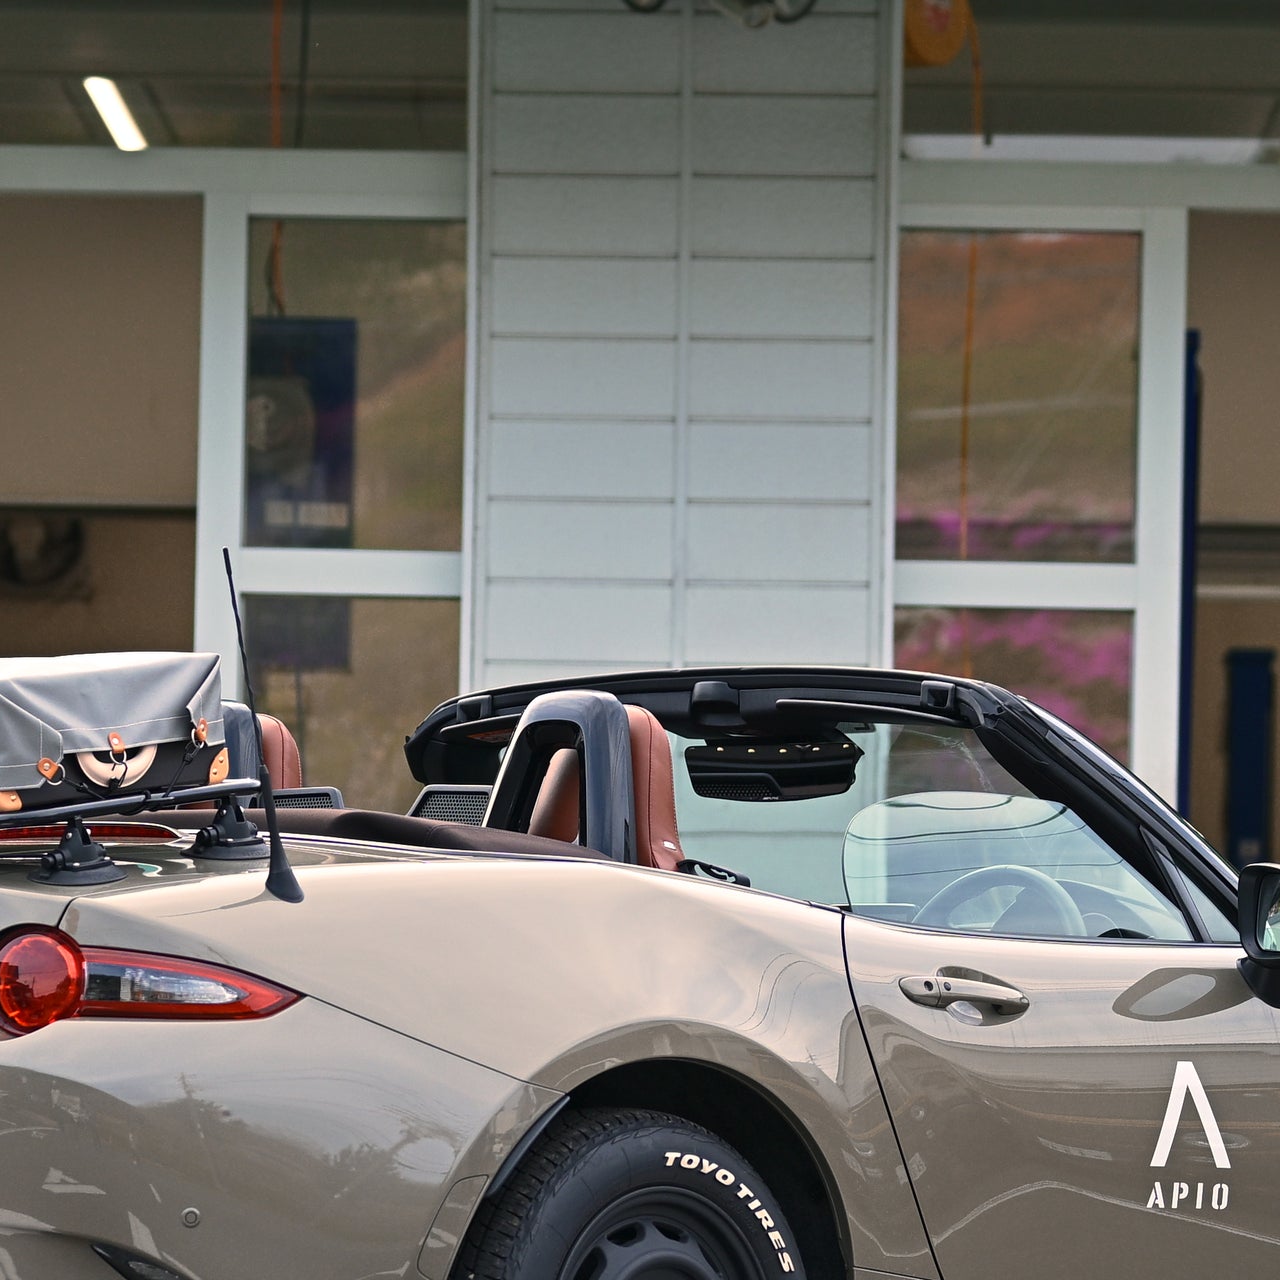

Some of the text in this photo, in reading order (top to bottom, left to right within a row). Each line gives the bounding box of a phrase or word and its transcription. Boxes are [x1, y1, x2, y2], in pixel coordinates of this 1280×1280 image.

[664, 1151, 795, 1273] TOYO TIRES
[1146, 1181, 1229, 1211] APIO
